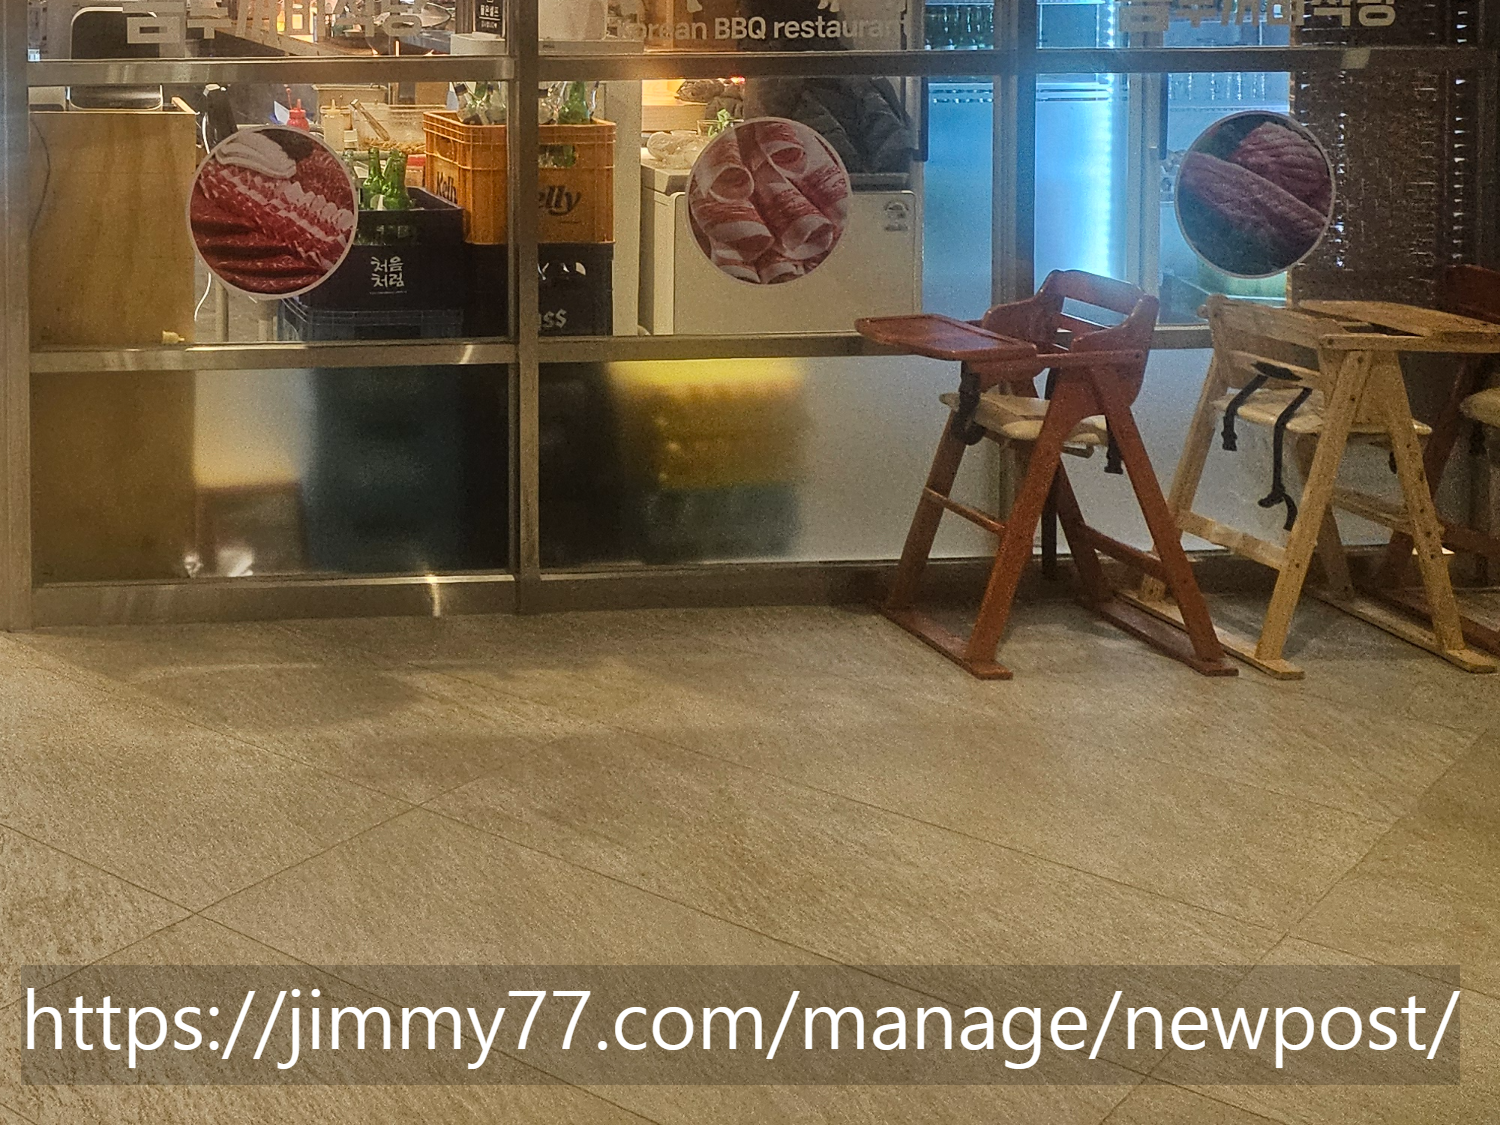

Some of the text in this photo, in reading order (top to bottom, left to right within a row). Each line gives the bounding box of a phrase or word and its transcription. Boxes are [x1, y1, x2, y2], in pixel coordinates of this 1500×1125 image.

[714, 16, 767, 41] BBQ
[370, 256, 404, 273] 처음
[371, 272, 405, 289] 처럼
